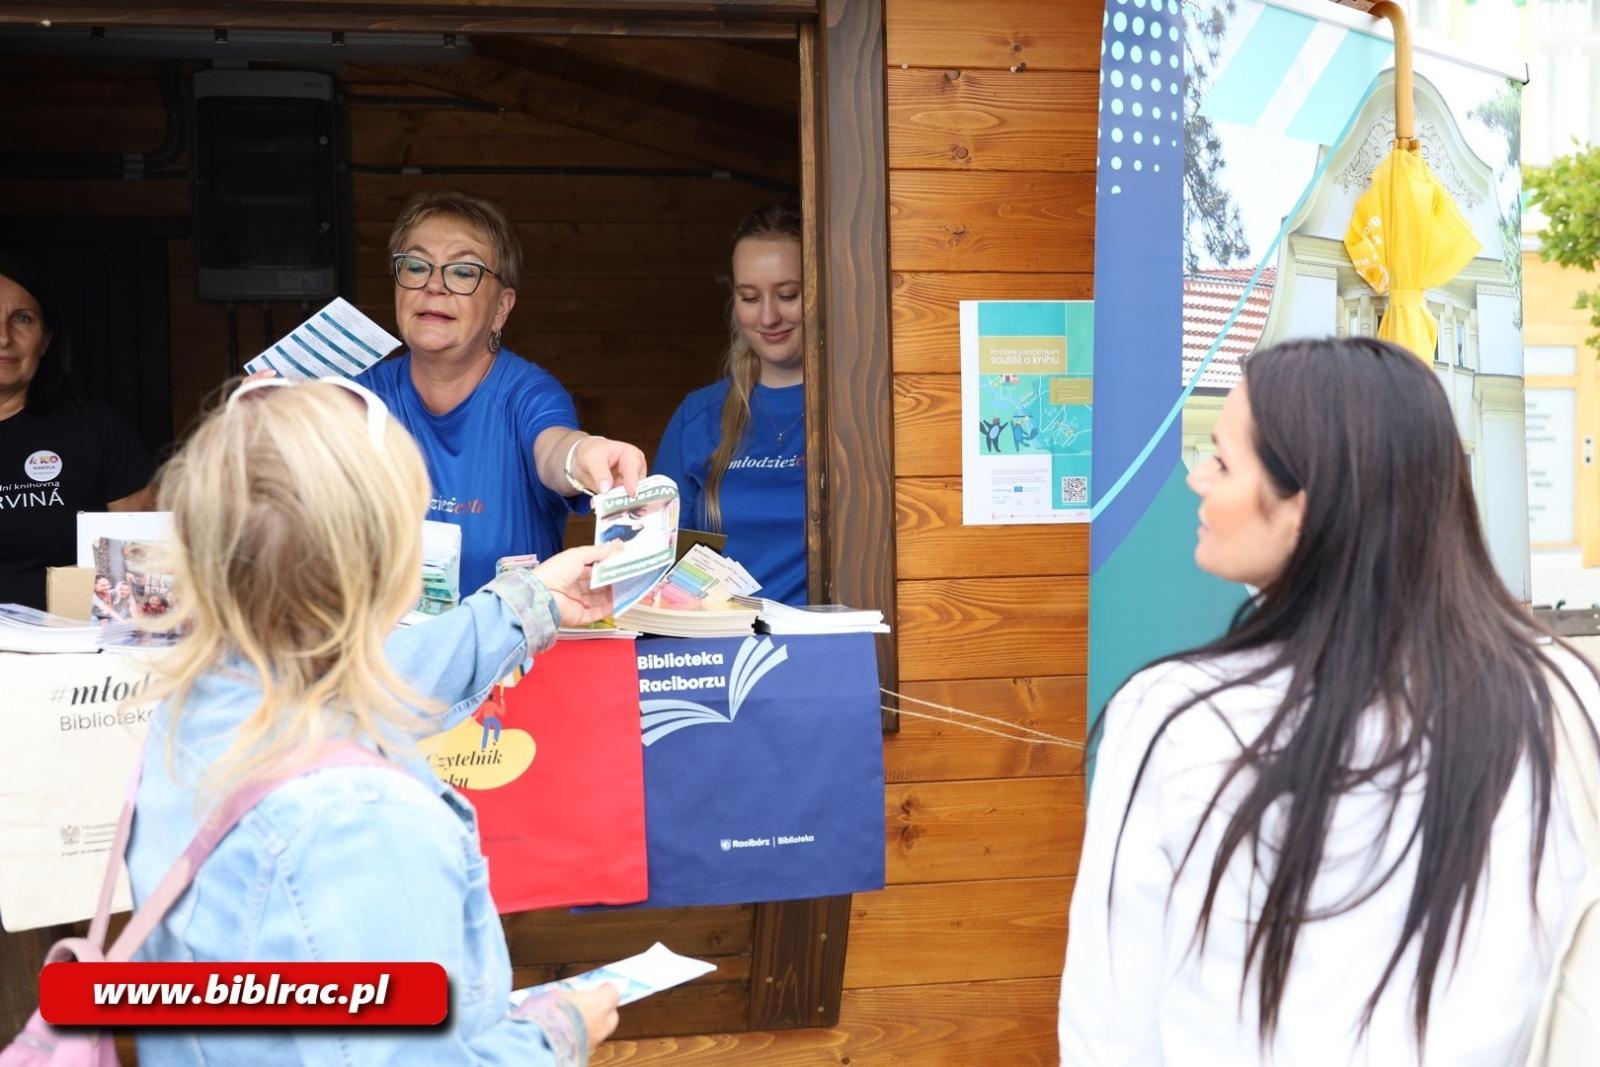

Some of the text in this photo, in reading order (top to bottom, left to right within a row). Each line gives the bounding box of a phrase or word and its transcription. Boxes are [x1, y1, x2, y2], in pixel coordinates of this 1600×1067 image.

[14, 481, 60, 490] knihovna
[637, 651, 724, 670] Biblioteka
[639, 675, 726, 693] Raciborzu
[778, 834, 815, 845] Biblioteka
